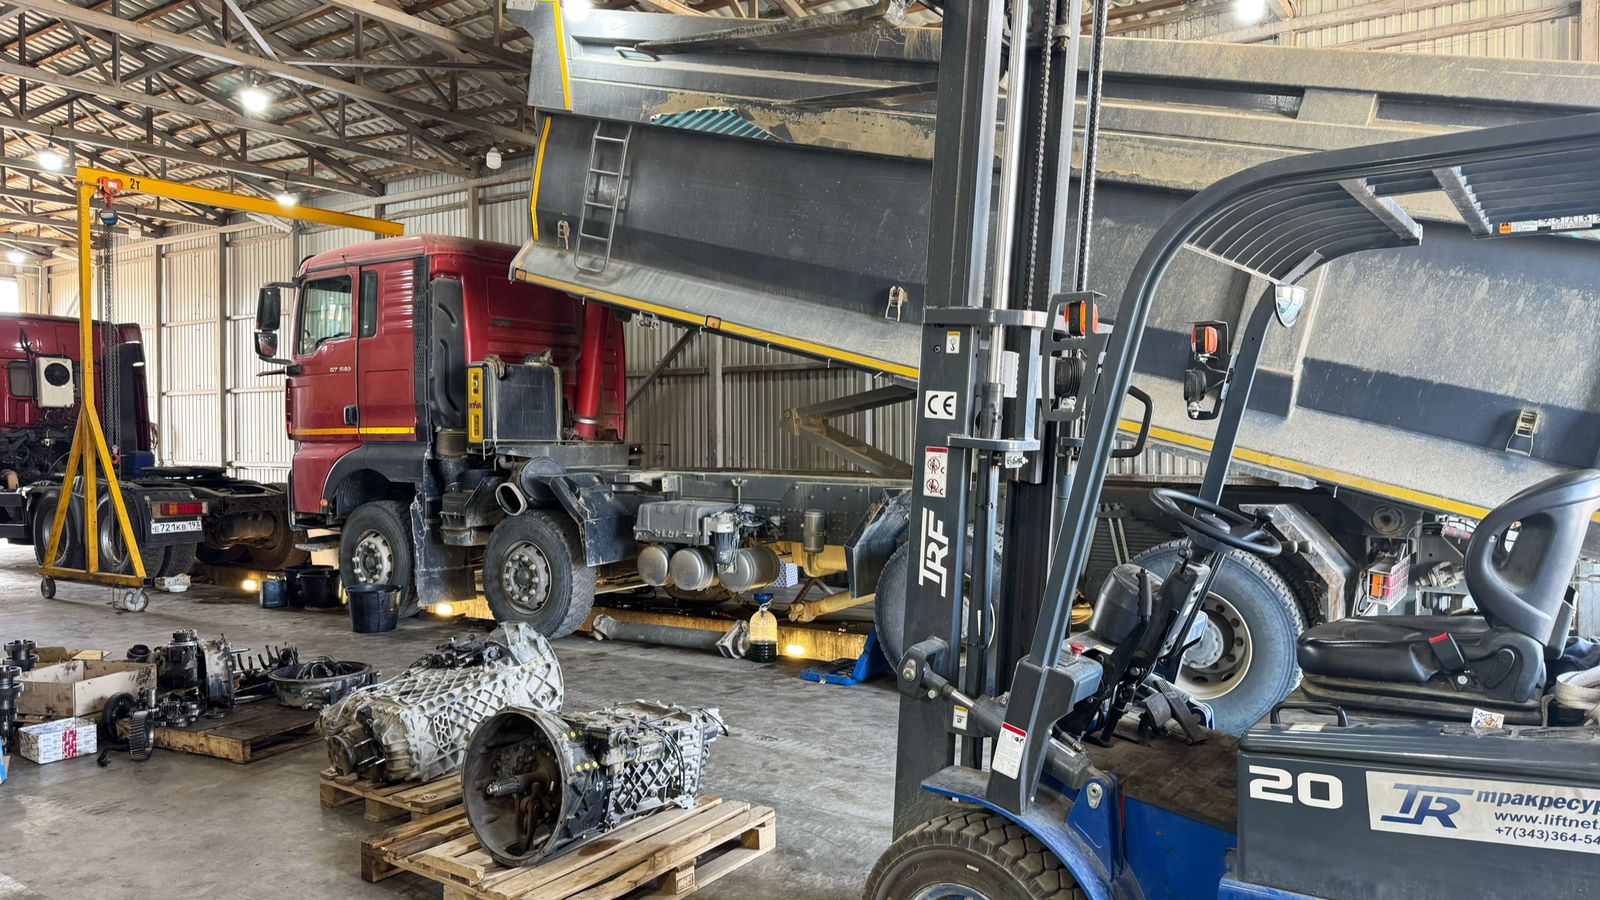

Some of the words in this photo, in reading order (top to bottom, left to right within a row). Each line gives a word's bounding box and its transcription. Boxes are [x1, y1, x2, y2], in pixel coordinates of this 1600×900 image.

[928, 394, 954, 416] CE
[1248, 764, 1344, 810] 20
[1495, 826, 1600, 846] +7(343)364-54
